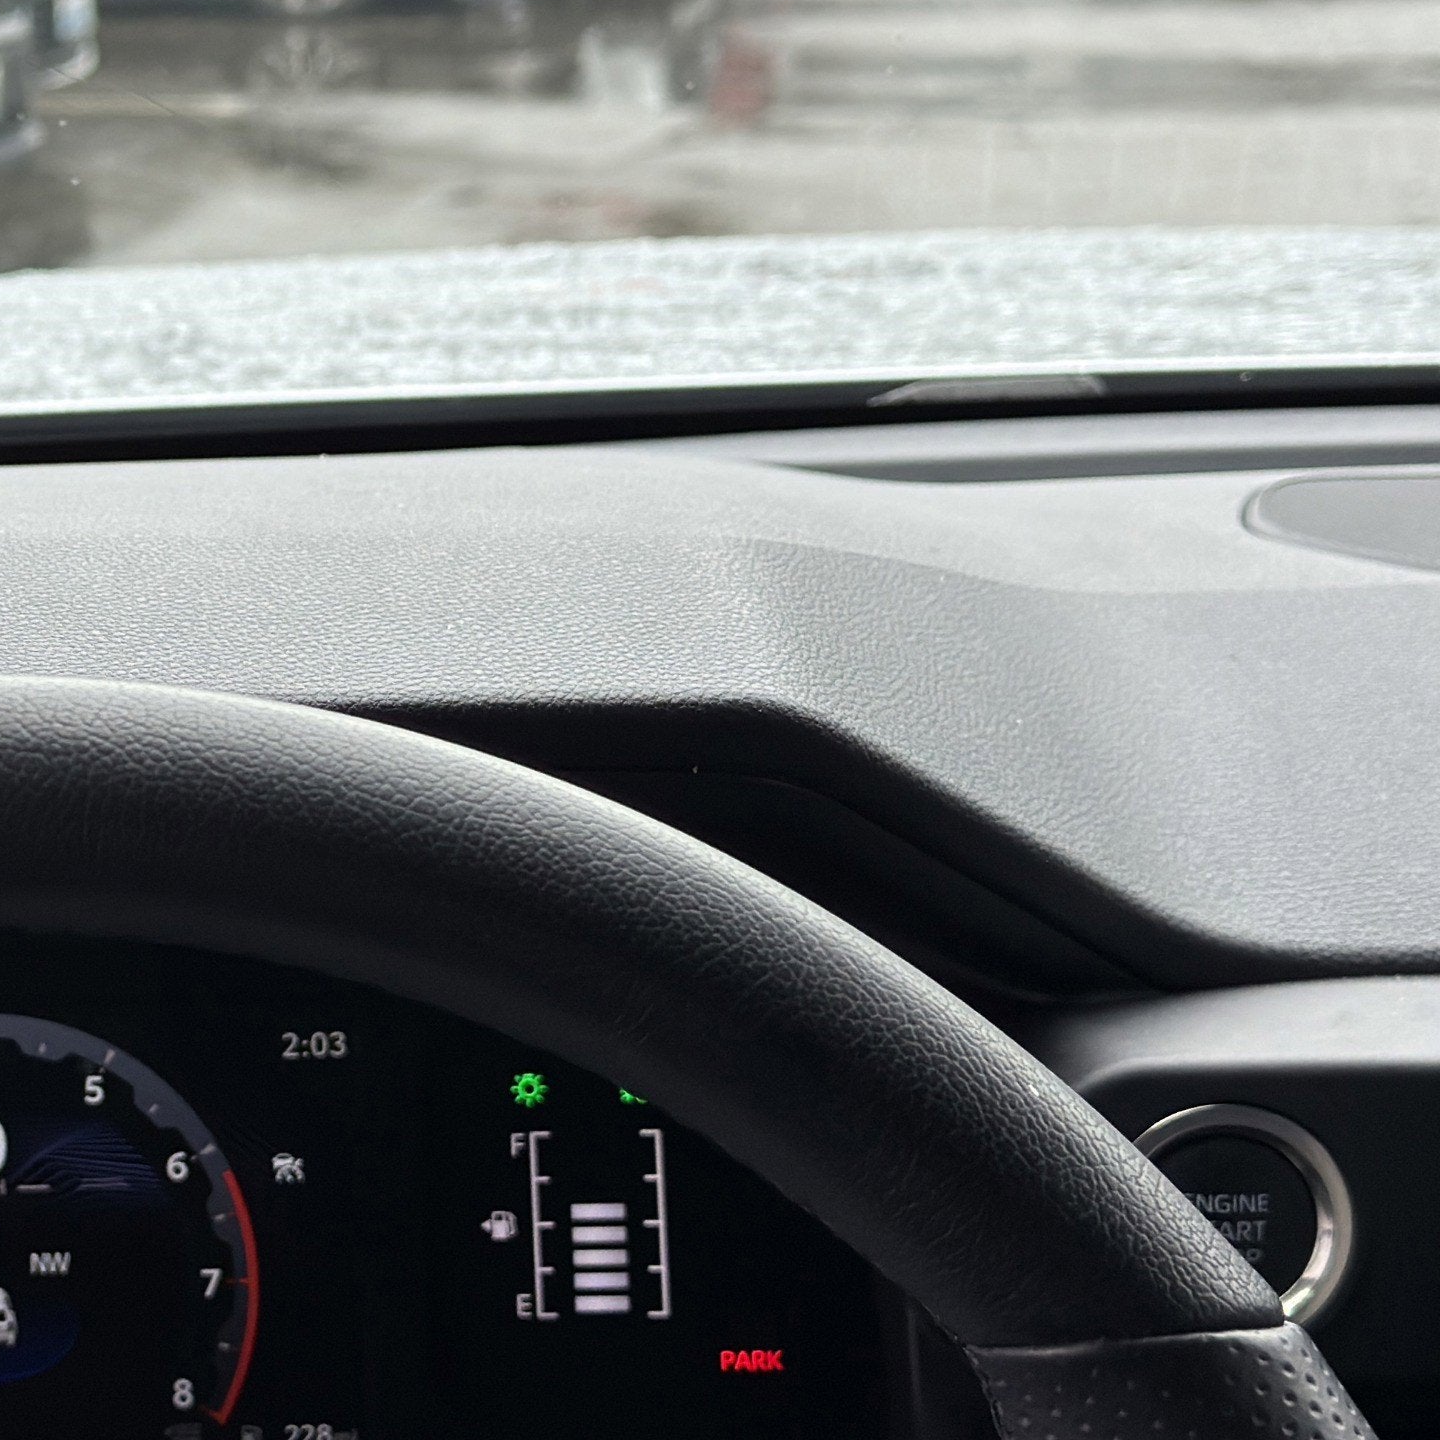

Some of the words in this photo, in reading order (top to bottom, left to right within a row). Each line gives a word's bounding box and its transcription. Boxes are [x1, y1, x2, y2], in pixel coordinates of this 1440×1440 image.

[282, 1031, 348, 1060] 2:03
[84, 1075, 105, 1106] 5
[510, 1132, 526, 1158] F
[166, 1151, 189, 1182] 6
[29, 1252, 71, 1275] NW
[200, 1268, 223, 1300] 7
[516, 1294, 533, 1319] E
[720, 1349, 785, 1373] PARK
[172, 1378, 194, 1410] 8
